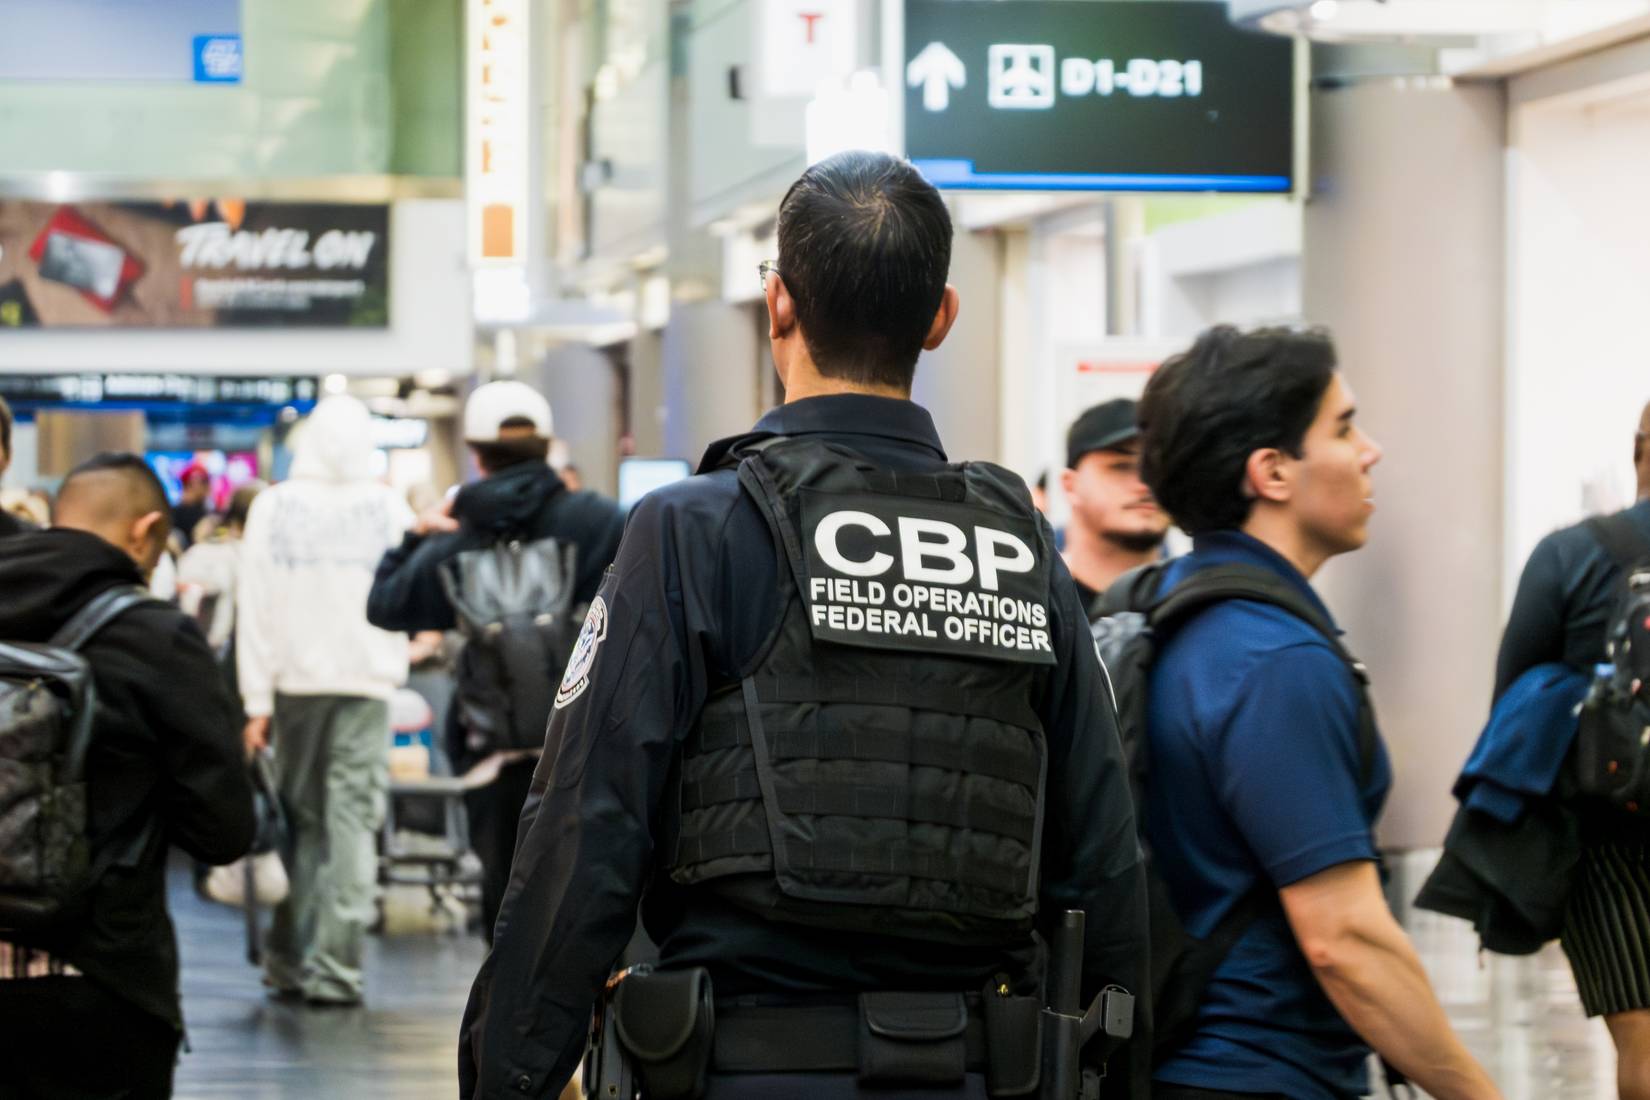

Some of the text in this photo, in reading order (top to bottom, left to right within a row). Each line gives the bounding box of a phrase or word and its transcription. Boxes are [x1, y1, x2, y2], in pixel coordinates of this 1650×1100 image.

[1061, 58, 1202, 97] D1-D21
[176, 222, 375, 269] TRAVEL ON
[814, 510, 1035, 591] CBP
[810, 577, 1047, 628] FIELD OPERATIONS
[811, 604, 1052, 652] FEDERAL OFFICER
